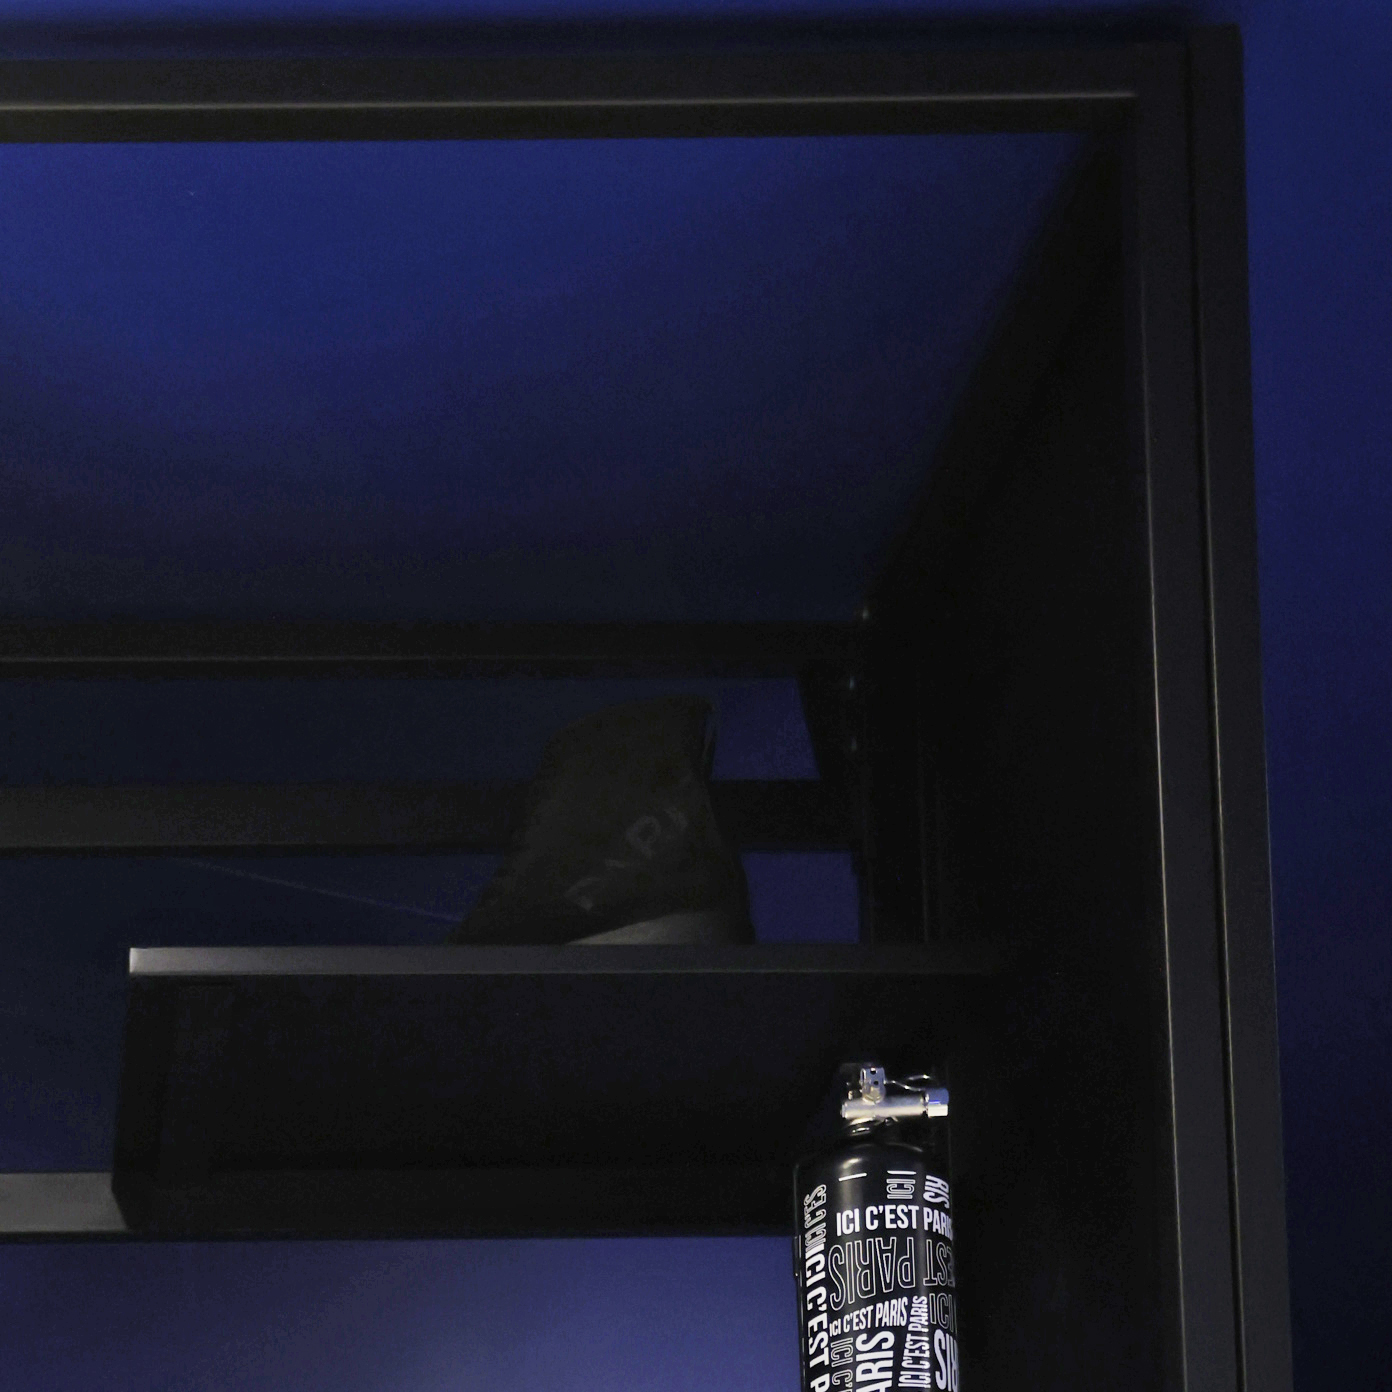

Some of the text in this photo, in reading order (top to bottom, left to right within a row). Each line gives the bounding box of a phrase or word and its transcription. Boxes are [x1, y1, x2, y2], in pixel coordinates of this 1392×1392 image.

[836, 1208, 861, 1237] ICI
[865, 1204, 920, 1231] C'EST
[806, 1244, 826, 1288] ICI
[828, 1236, 916, 1311] PARIS
[829, 1296, 909, 1338] ICI C'EST PARIS
[907, 1295, 929, 1333] PARIS
[830, 1337, 854, 1368] ICI
